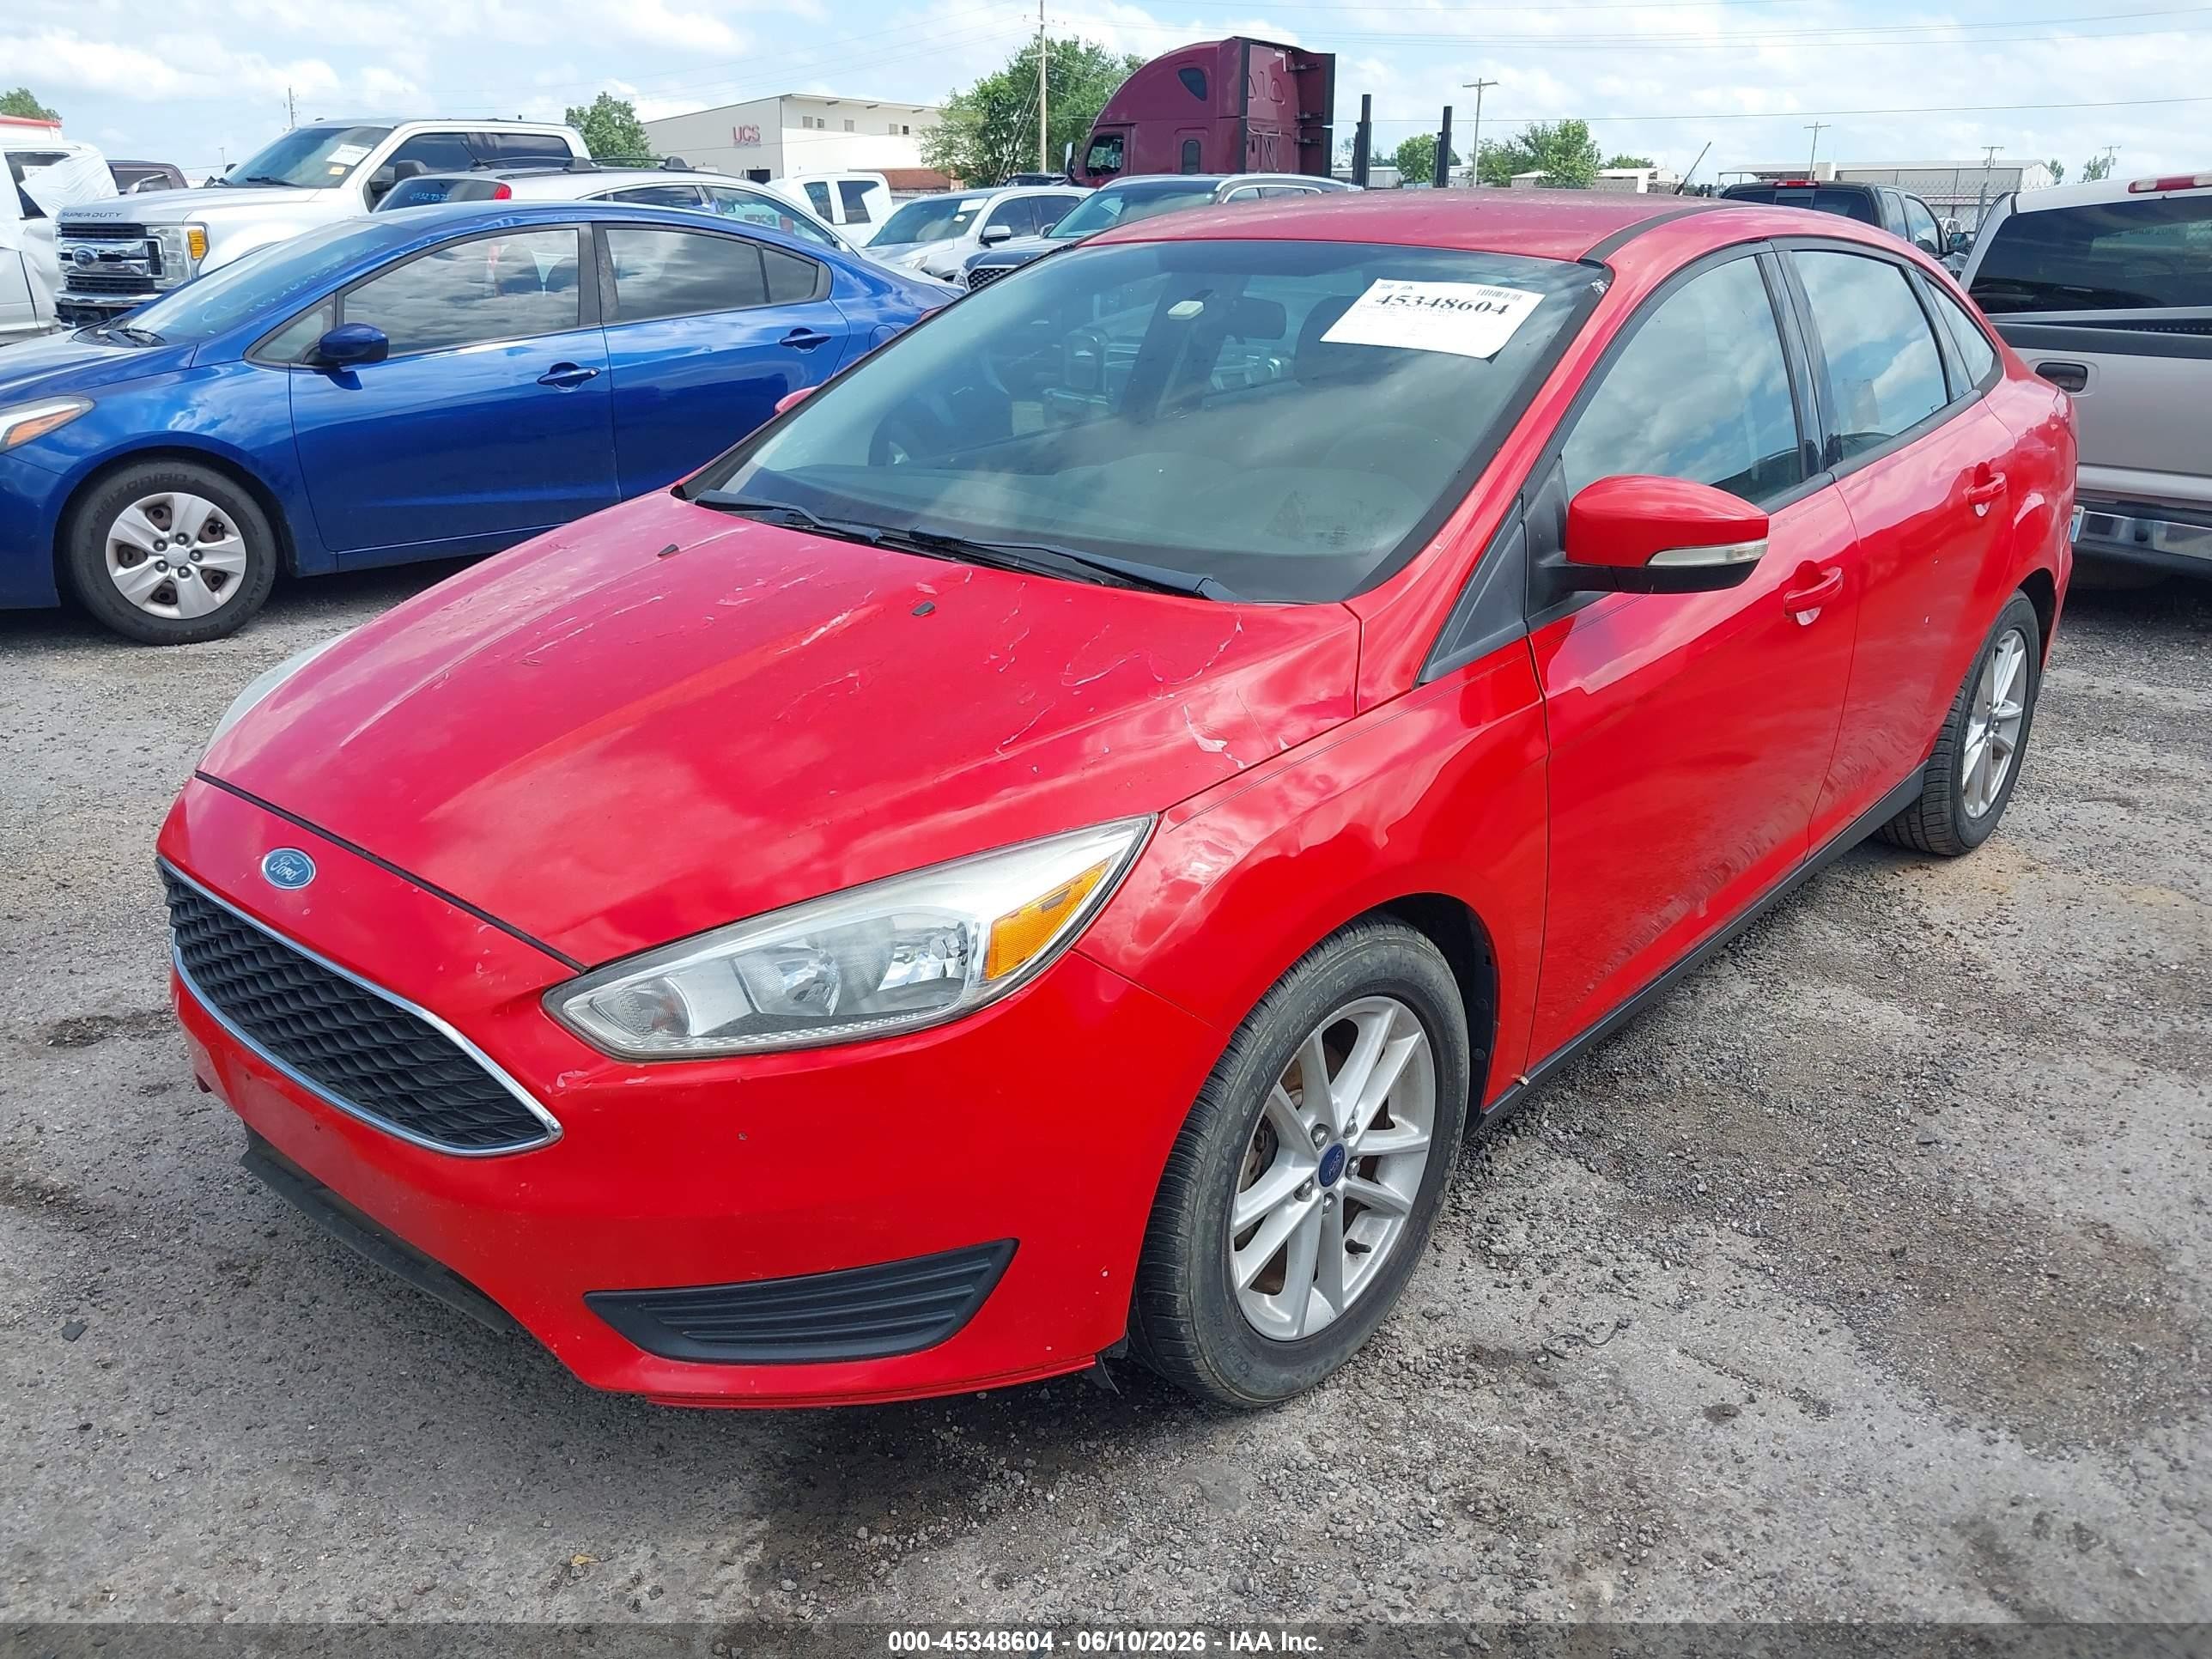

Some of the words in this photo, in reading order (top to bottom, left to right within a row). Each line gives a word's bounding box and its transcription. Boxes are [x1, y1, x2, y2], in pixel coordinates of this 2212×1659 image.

[732, 125, 761, 143] UCS
[1374, 294, 1510, 316] 45348604
[270, 855, 303, 882] Ford
